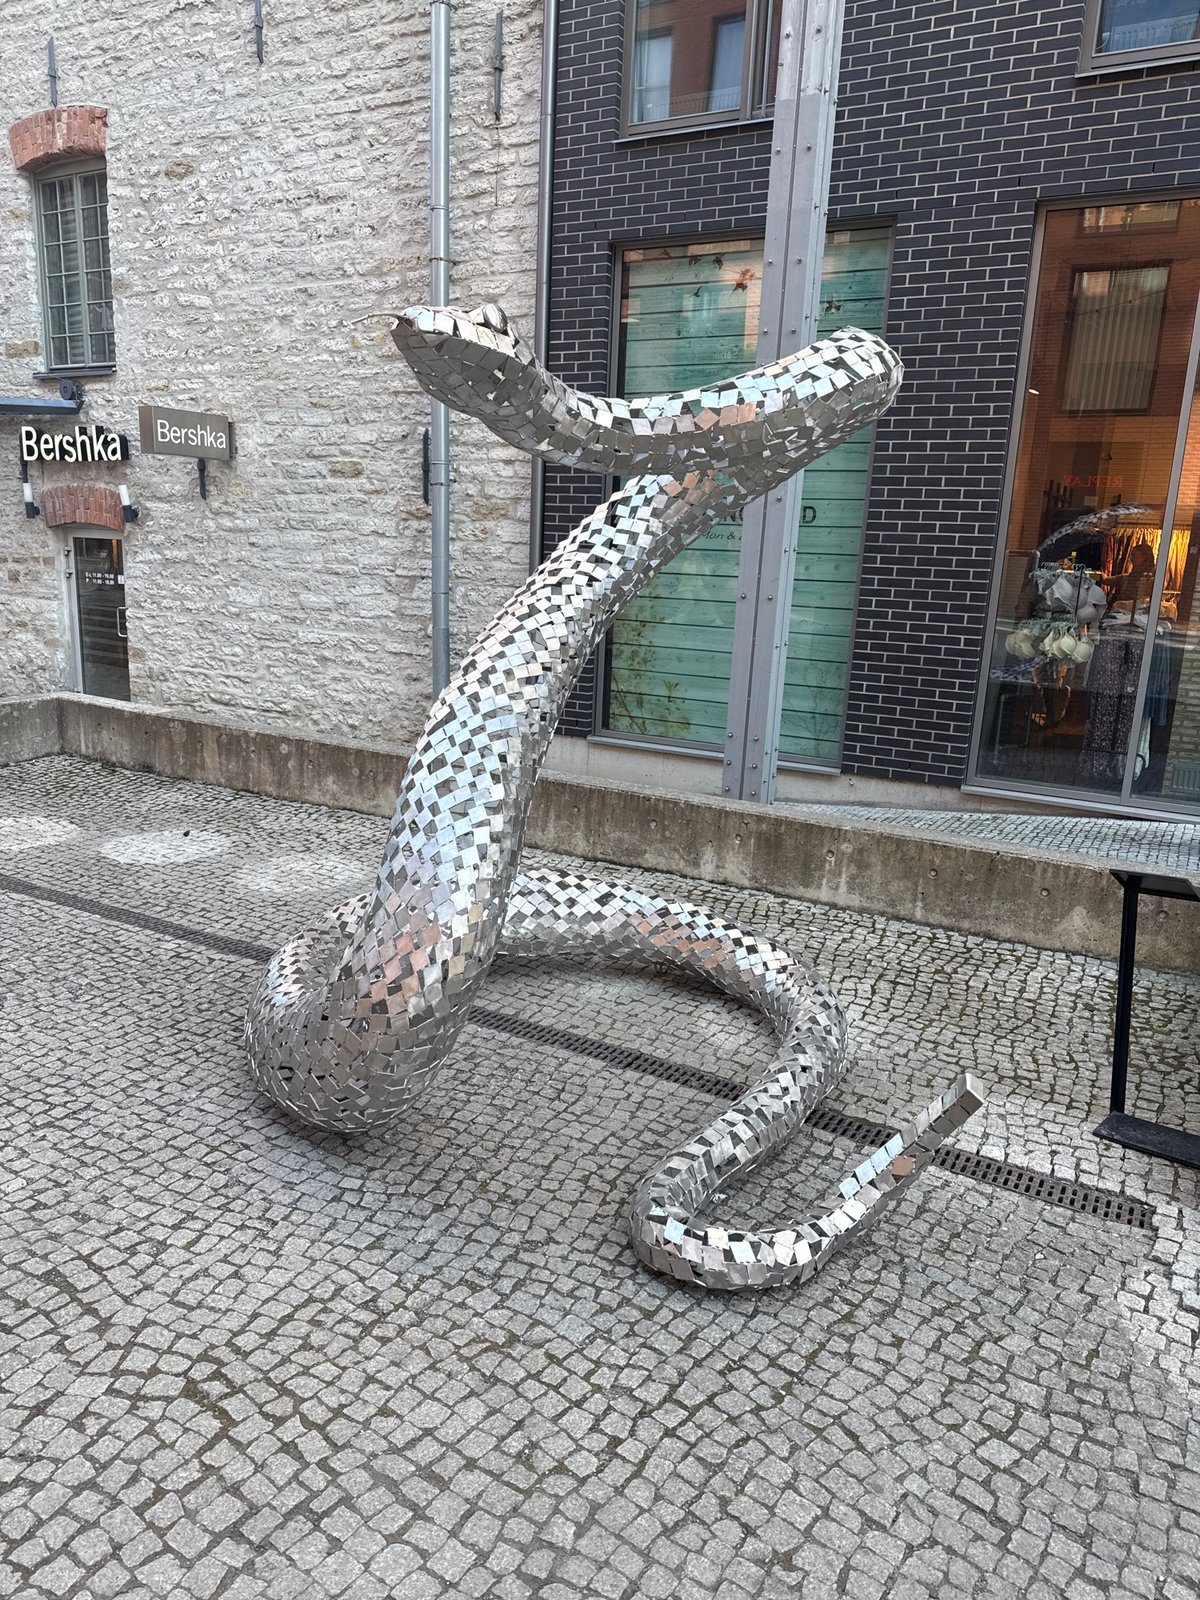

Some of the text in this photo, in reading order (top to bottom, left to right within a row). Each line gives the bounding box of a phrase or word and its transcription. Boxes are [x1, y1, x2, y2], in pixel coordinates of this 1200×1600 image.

[21, 425, 122, 462] Bershka
[157, 419, 227, 449] Bershka
[727, 531, 736, 540] &
